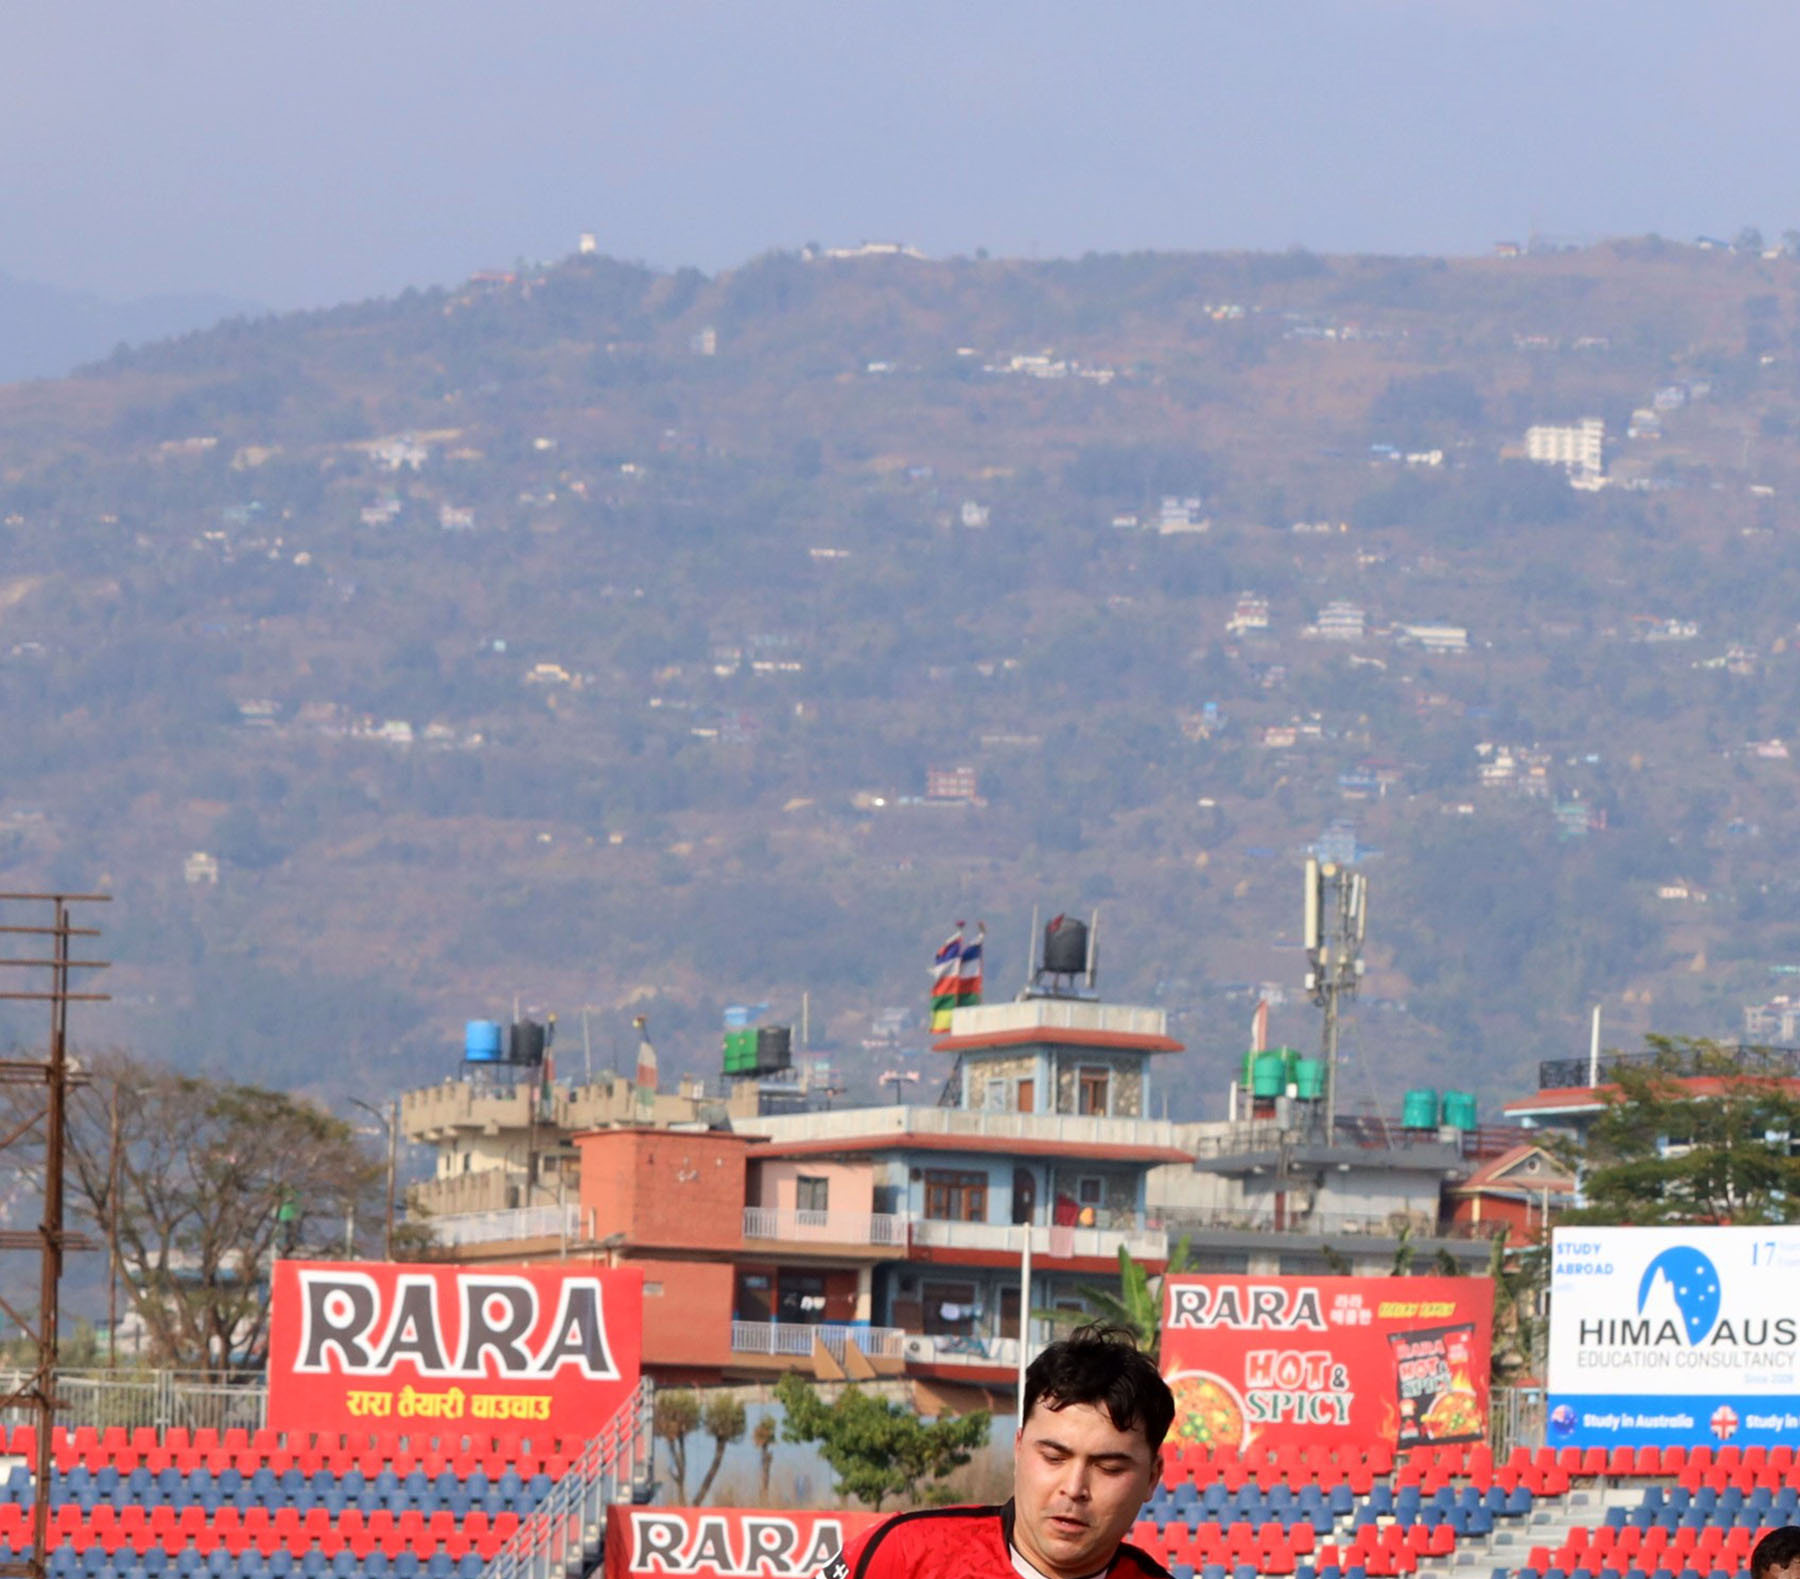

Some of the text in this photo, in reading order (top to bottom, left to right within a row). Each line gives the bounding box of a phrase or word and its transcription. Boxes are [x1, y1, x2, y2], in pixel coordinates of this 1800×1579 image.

[1557, 1243, 1602, 1255] STUDY
[1752, 1242, 1776, 1266] 17
[1556, 1263, 1614, 1275] ABROAD
[1168, 1284, 1328, 1331] RARA
[293, 1271, 621, 1380] RARA
[1245, 1350, 1346, 1389] HOT &
[1577, 1351, 1795, 1369] EDUCATION CONSULTANCY
[346, 1390, 393, 1417] रारा
[1246, 1391, 1354, 1425] SPICY
[1584, 1413, 1694, 1431] Study in Australia
[1746, 1414, 1781, 1432] Study
[1784, 1414, 1798, 1428] in
[629, 1512, 843, 1579] RARA
